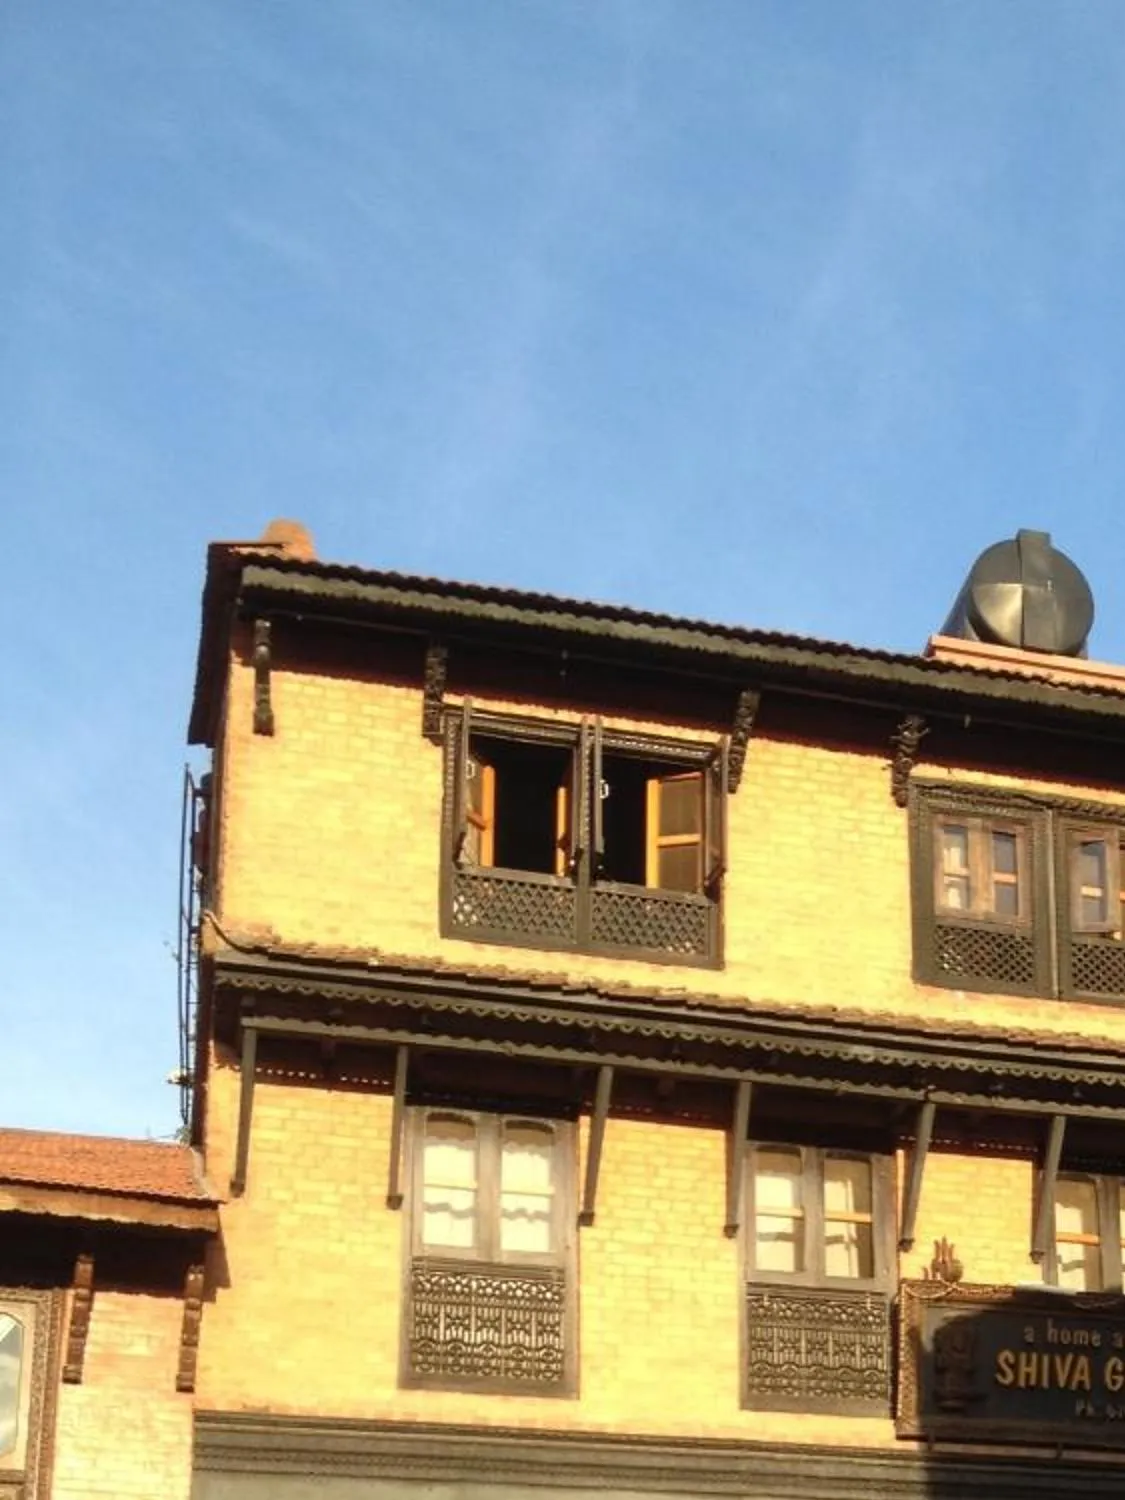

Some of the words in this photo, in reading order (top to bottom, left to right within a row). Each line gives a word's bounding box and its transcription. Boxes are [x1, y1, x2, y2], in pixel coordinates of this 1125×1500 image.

[1023, 1326, 1035, 1345] a
[1046, 1319, 1101, 1347] home
[996, 1348, 1092, 1391] SHIVA
